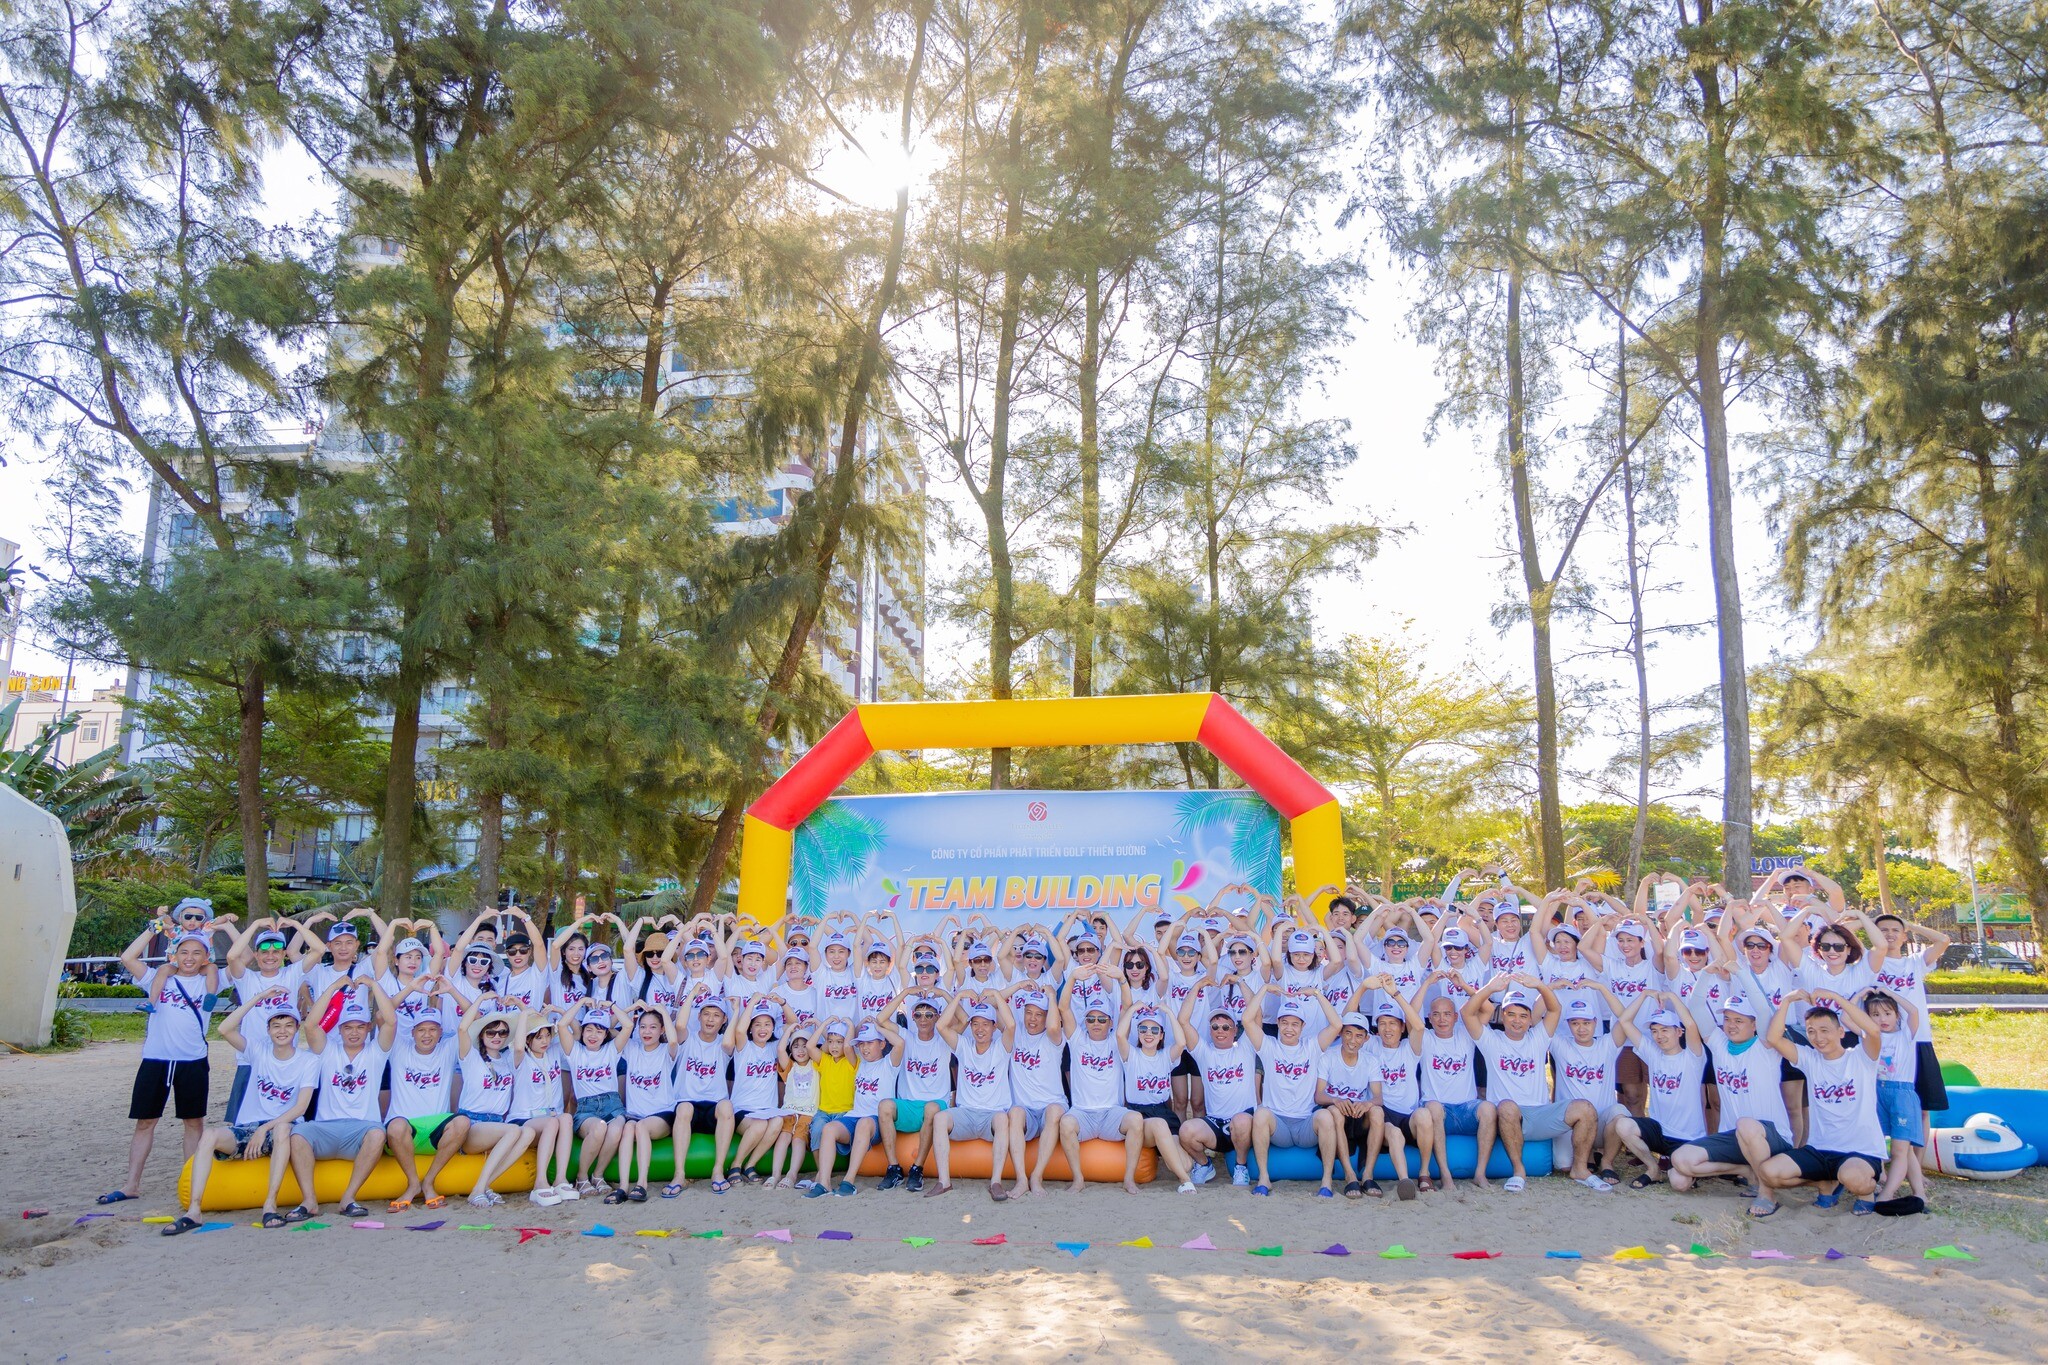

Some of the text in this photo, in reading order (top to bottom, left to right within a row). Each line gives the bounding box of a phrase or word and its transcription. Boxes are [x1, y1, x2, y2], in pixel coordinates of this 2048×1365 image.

[7, 676, 27, 692] NG
[931, 848, 955, 860] CÔNG
[957, 848, 969, 859] TY
[970, 844, 982, 858] CỔ
[1010, 846, 1032, 858] PHÁT
[1036, 843, 1061, 857] TRIỂN
[1063, 846, 1085, 857] GOLF
[1088, 844, 1114, 856] THIÊN
[1116, 844, 1146, 856] ĐƯỜNG
[907, 873, 1162, 910] TEAM BUILDING
